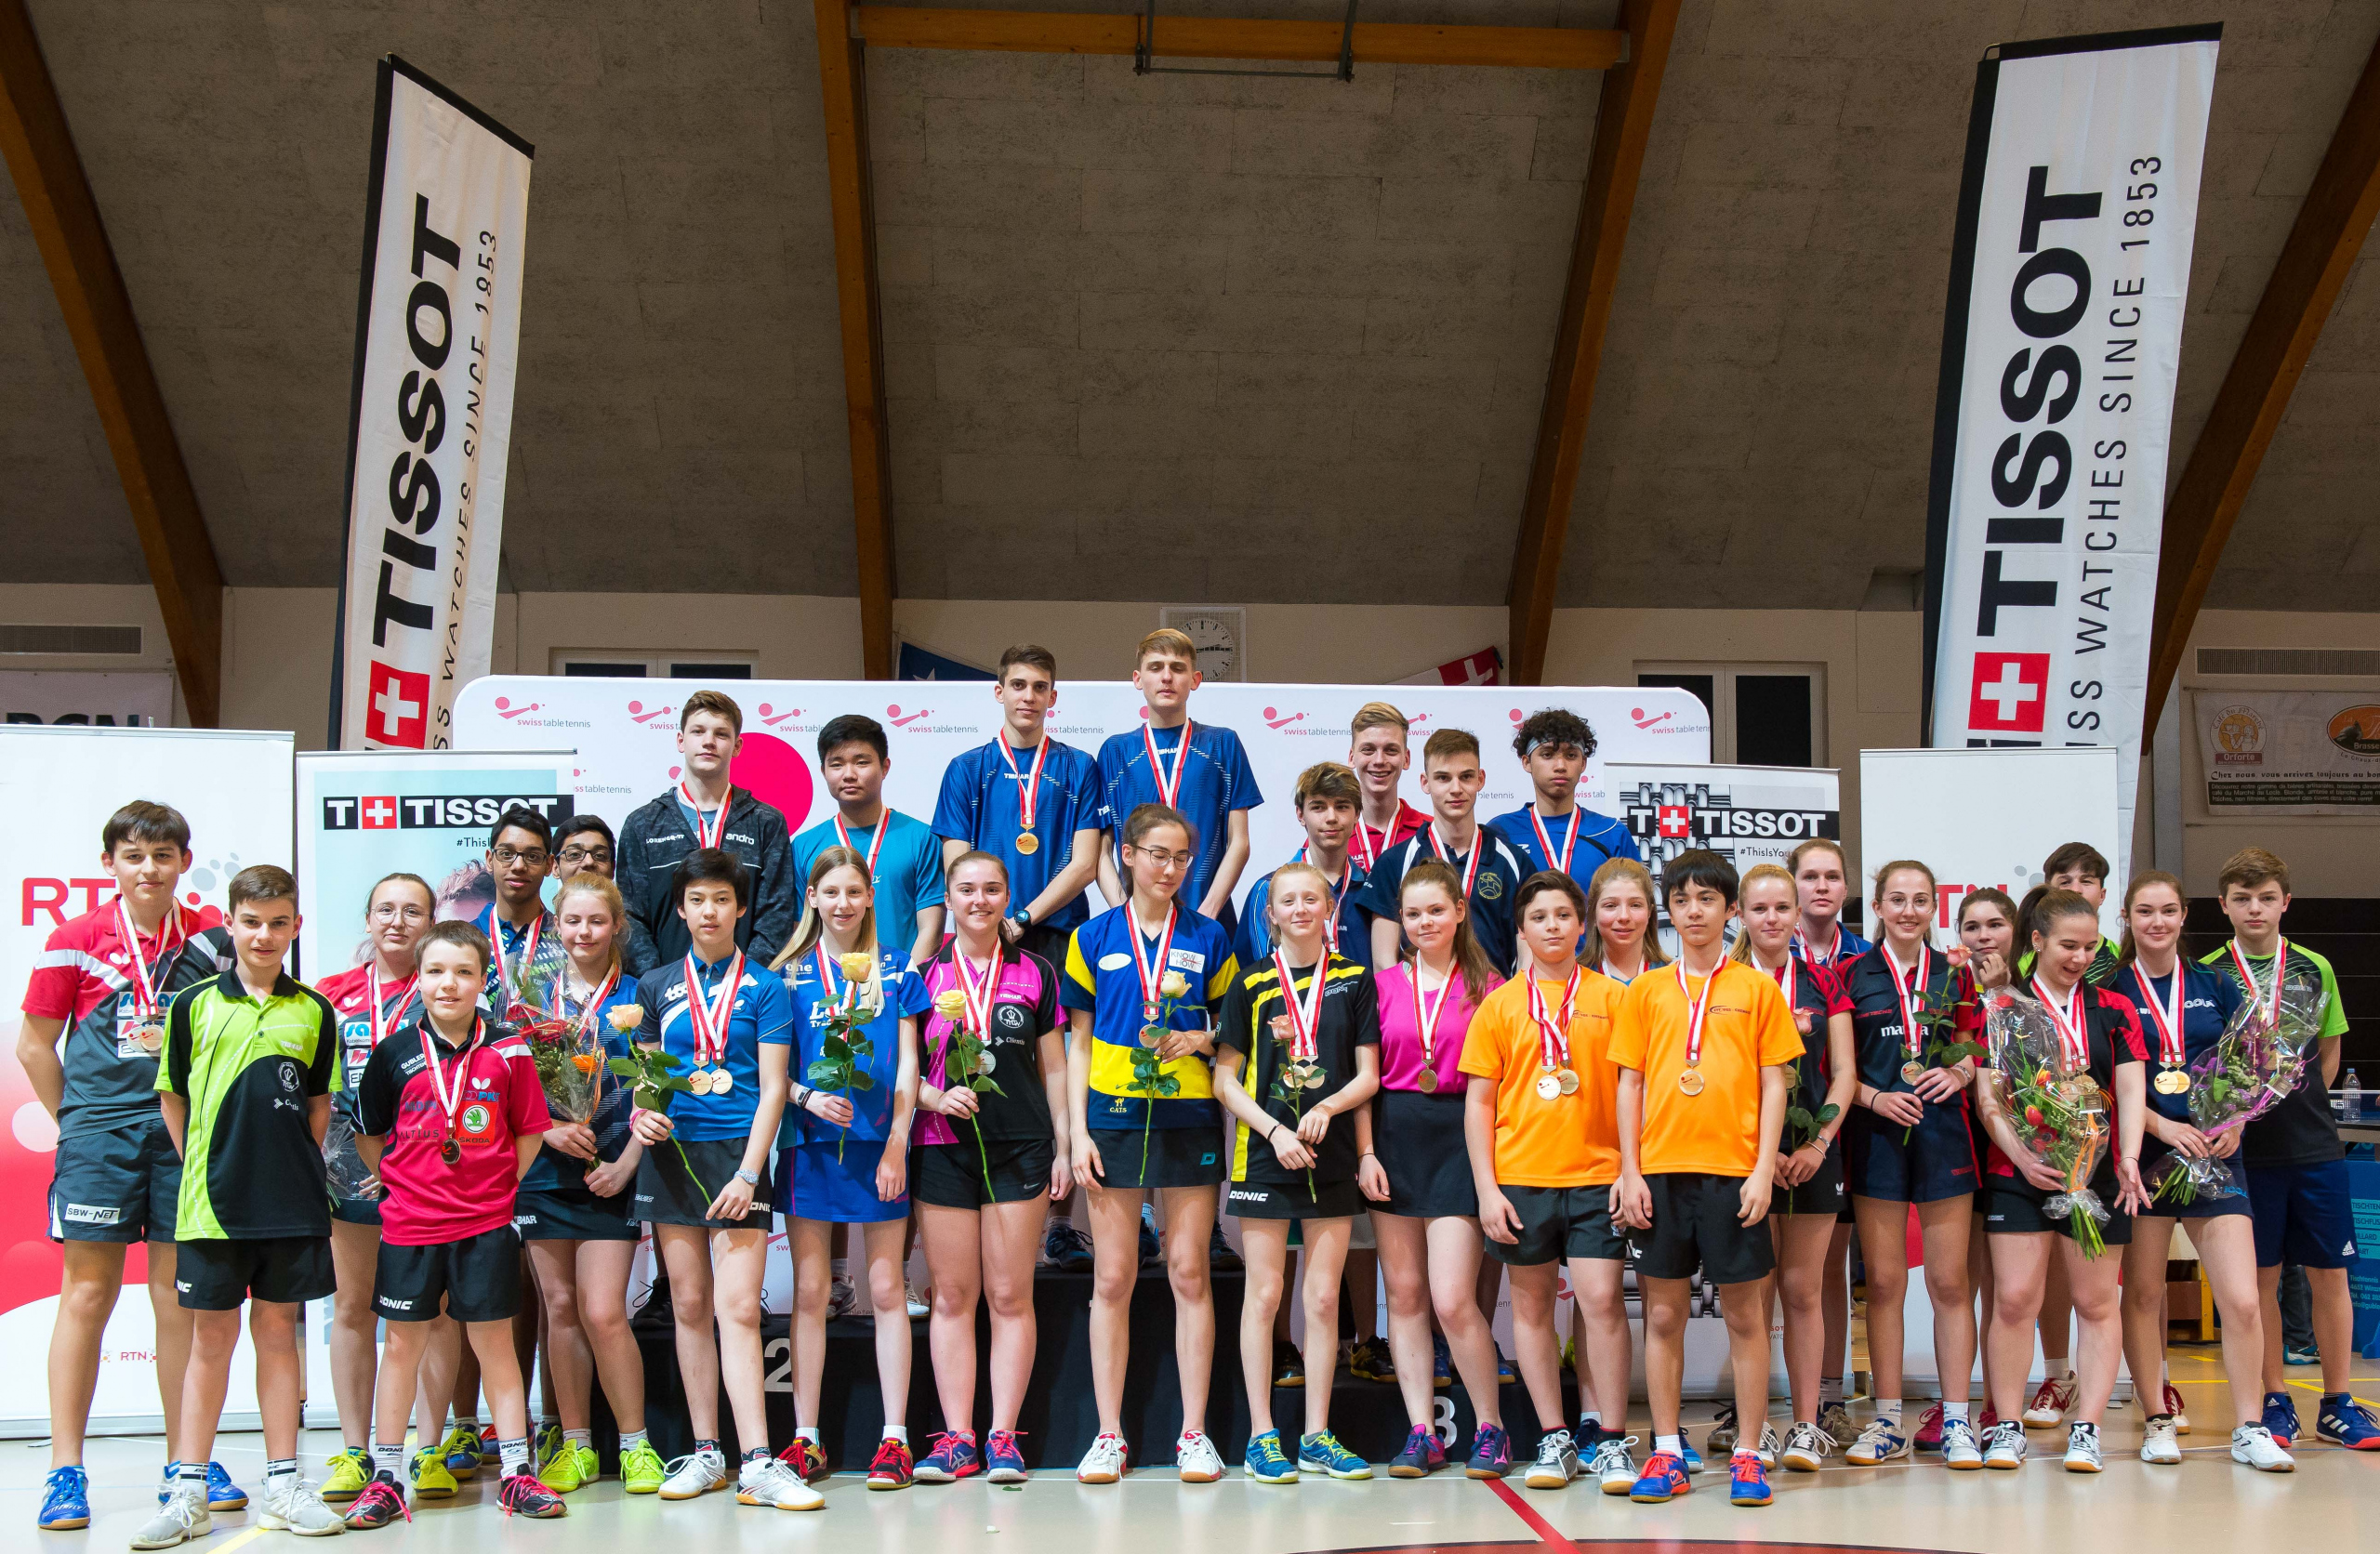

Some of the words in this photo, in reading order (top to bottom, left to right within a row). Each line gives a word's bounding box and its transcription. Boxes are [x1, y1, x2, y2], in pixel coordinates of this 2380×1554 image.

[2121, 155, 2162, 252] 1853
[2099, 276, 2146, 414] SINCE
[1977, 165, 2103, 638] TISSOT
[373, 191, 461, 649] TISSOT
[443, 483, 472, 680] WATCHES
[463, 336, 486, 459] SINCE
[475, 230, 498, 314] 1853
[2075, 439, 2127, 655] WATCHES
[517, 718, 542, 727] swiss
[543, 718, 564, 727] table
[565, 719, 591, 728] tennis
[779, 724, 804, 732] swiss
[932, 725, 953, 733] table
[1059, 726, 1079, 734] table
[1079, 726, 1104, 734] tennis
[1308, 728, 1328, 736] table
[1329, 728, 1352, 736] tennis
[1651, 726, 1675, 734] swiss
[1675, 725, 1695, 733] table
[2353, 742, 2380, 750] Brasse
[2211, 770, 2232, 781] Chez
[2317, 770, 2350, 779] toujours
[585, 784, 605, 793] table
[606, 784, 632, 794] tennis
[1593, 789, 1605, 797] tab
[1490, 791, 1514, 799] tennis
[1695, 810, 1827, 837] TISSOT
[725, 833, 755, 846] andro
[21, 877, 116, 926] RT
[1170, 951, 1197, 961] KNOW
[1175, 959, 1195, 969] HOW
[2185, 997, 2215, 1009] OOLA
[401, 1053, 426, 1070] GUBLER
[1228, 1190, 1269, 1203] DONIC
[67, 1207, 119, 1221] SBW-NET
[2357, 1232, 2377, 1241] ILLARD
[120, 1350, 147, 1361] RTN
[765, 1339, 793, 1391] 2
